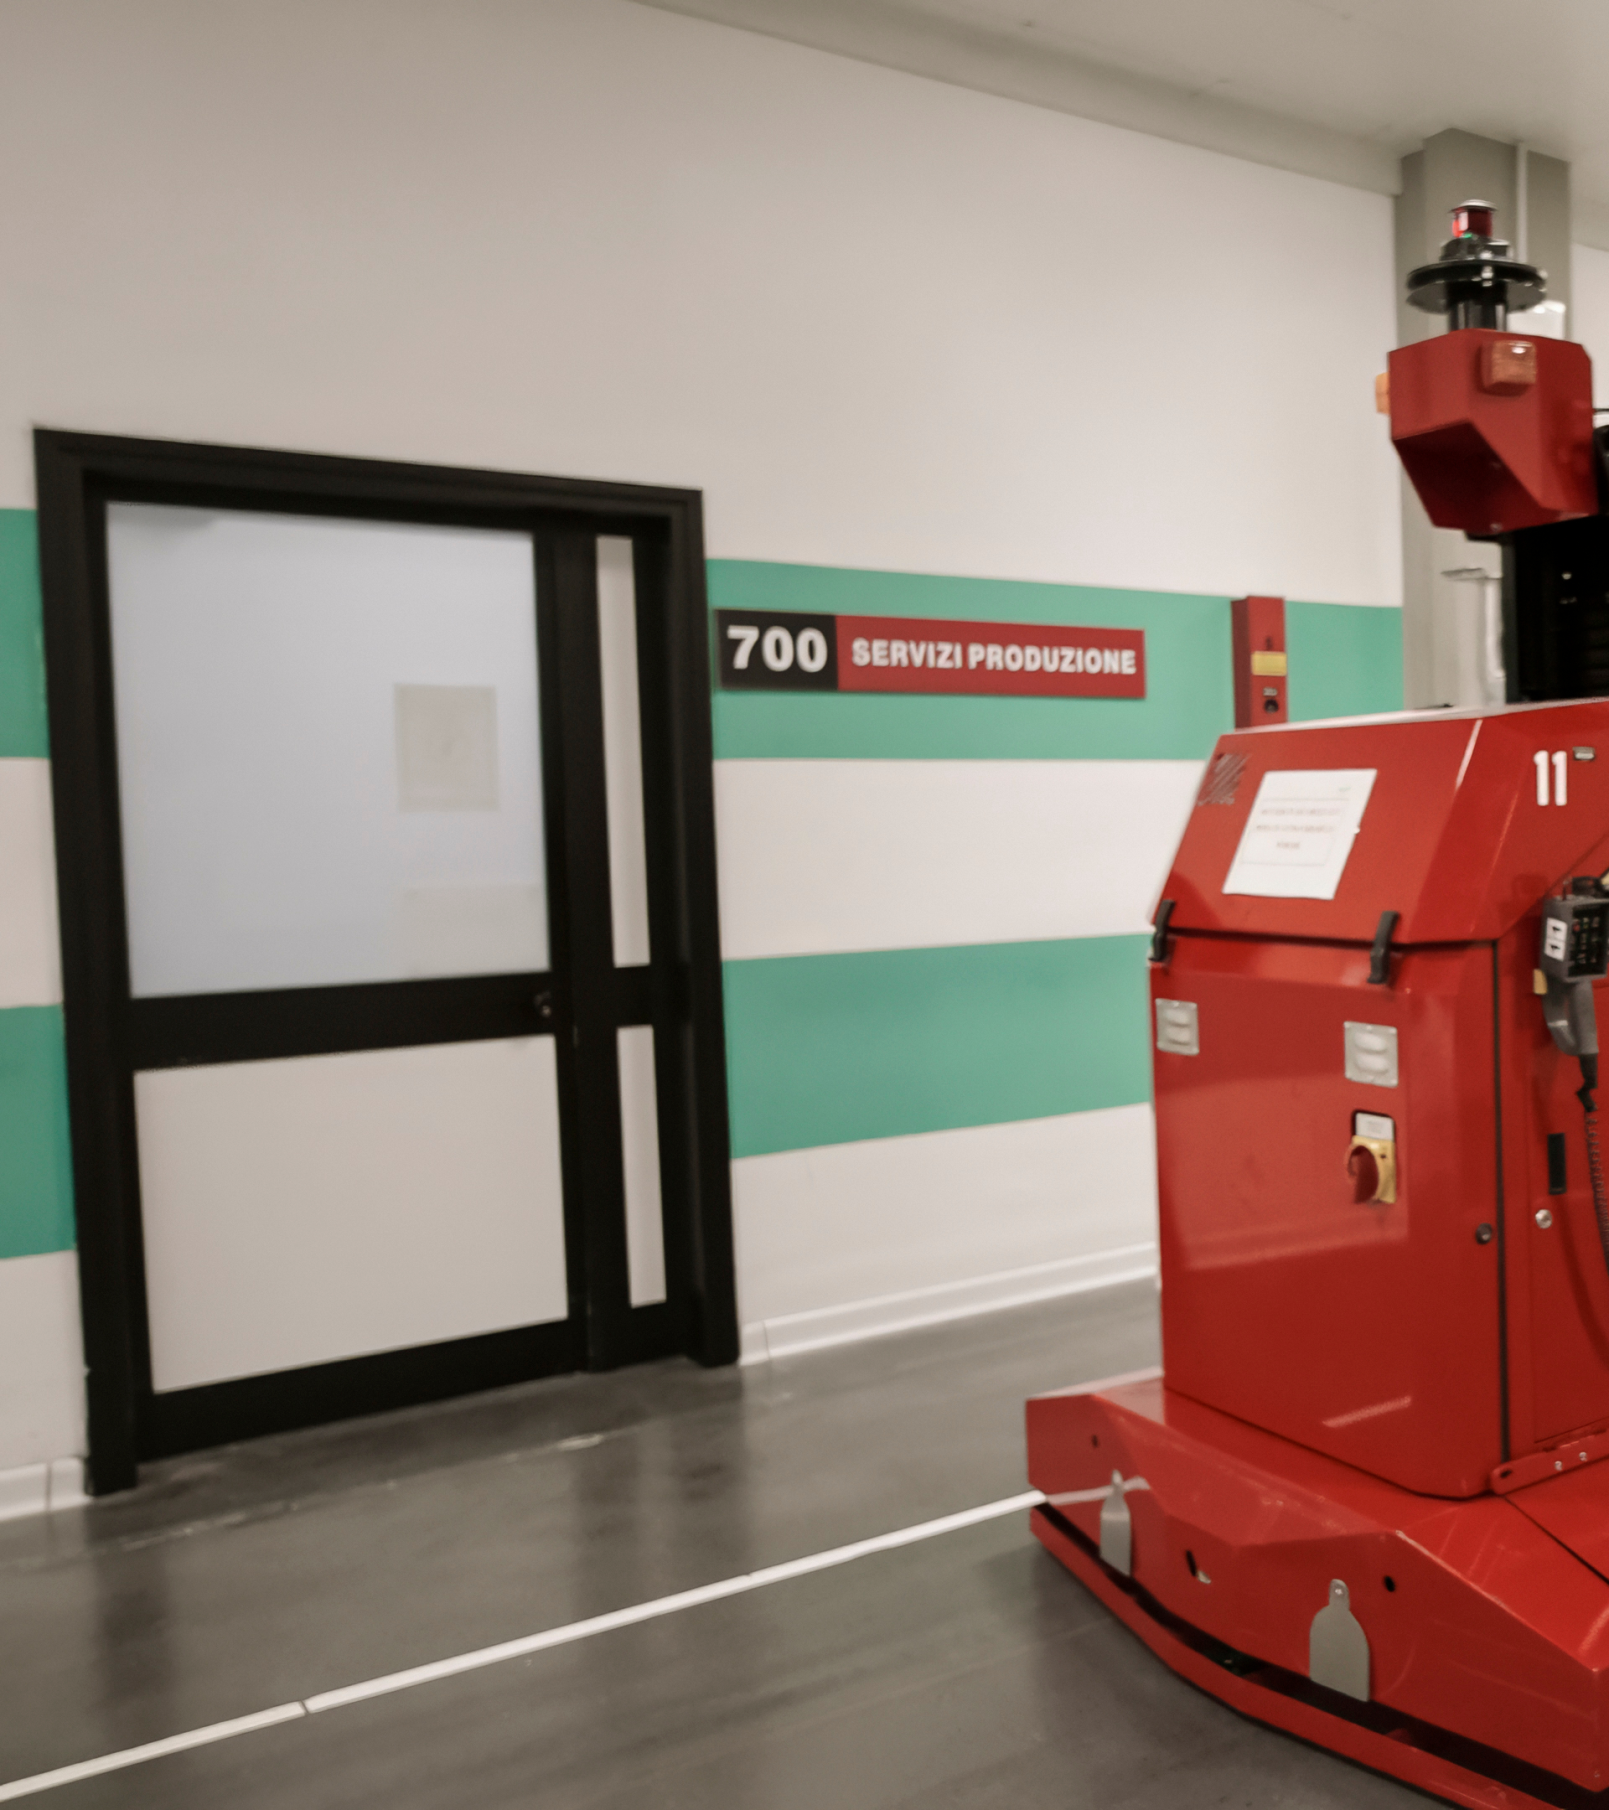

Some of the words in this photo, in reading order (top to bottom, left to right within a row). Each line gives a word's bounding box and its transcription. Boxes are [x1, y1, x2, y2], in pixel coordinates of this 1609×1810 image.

[727, 625, 828, 673] 700
[852, 637, 963, 669] SERVIZI
[967, 642, 1137, 675] PRODUZIONE
[1533, 750, 1567, 807] 11
